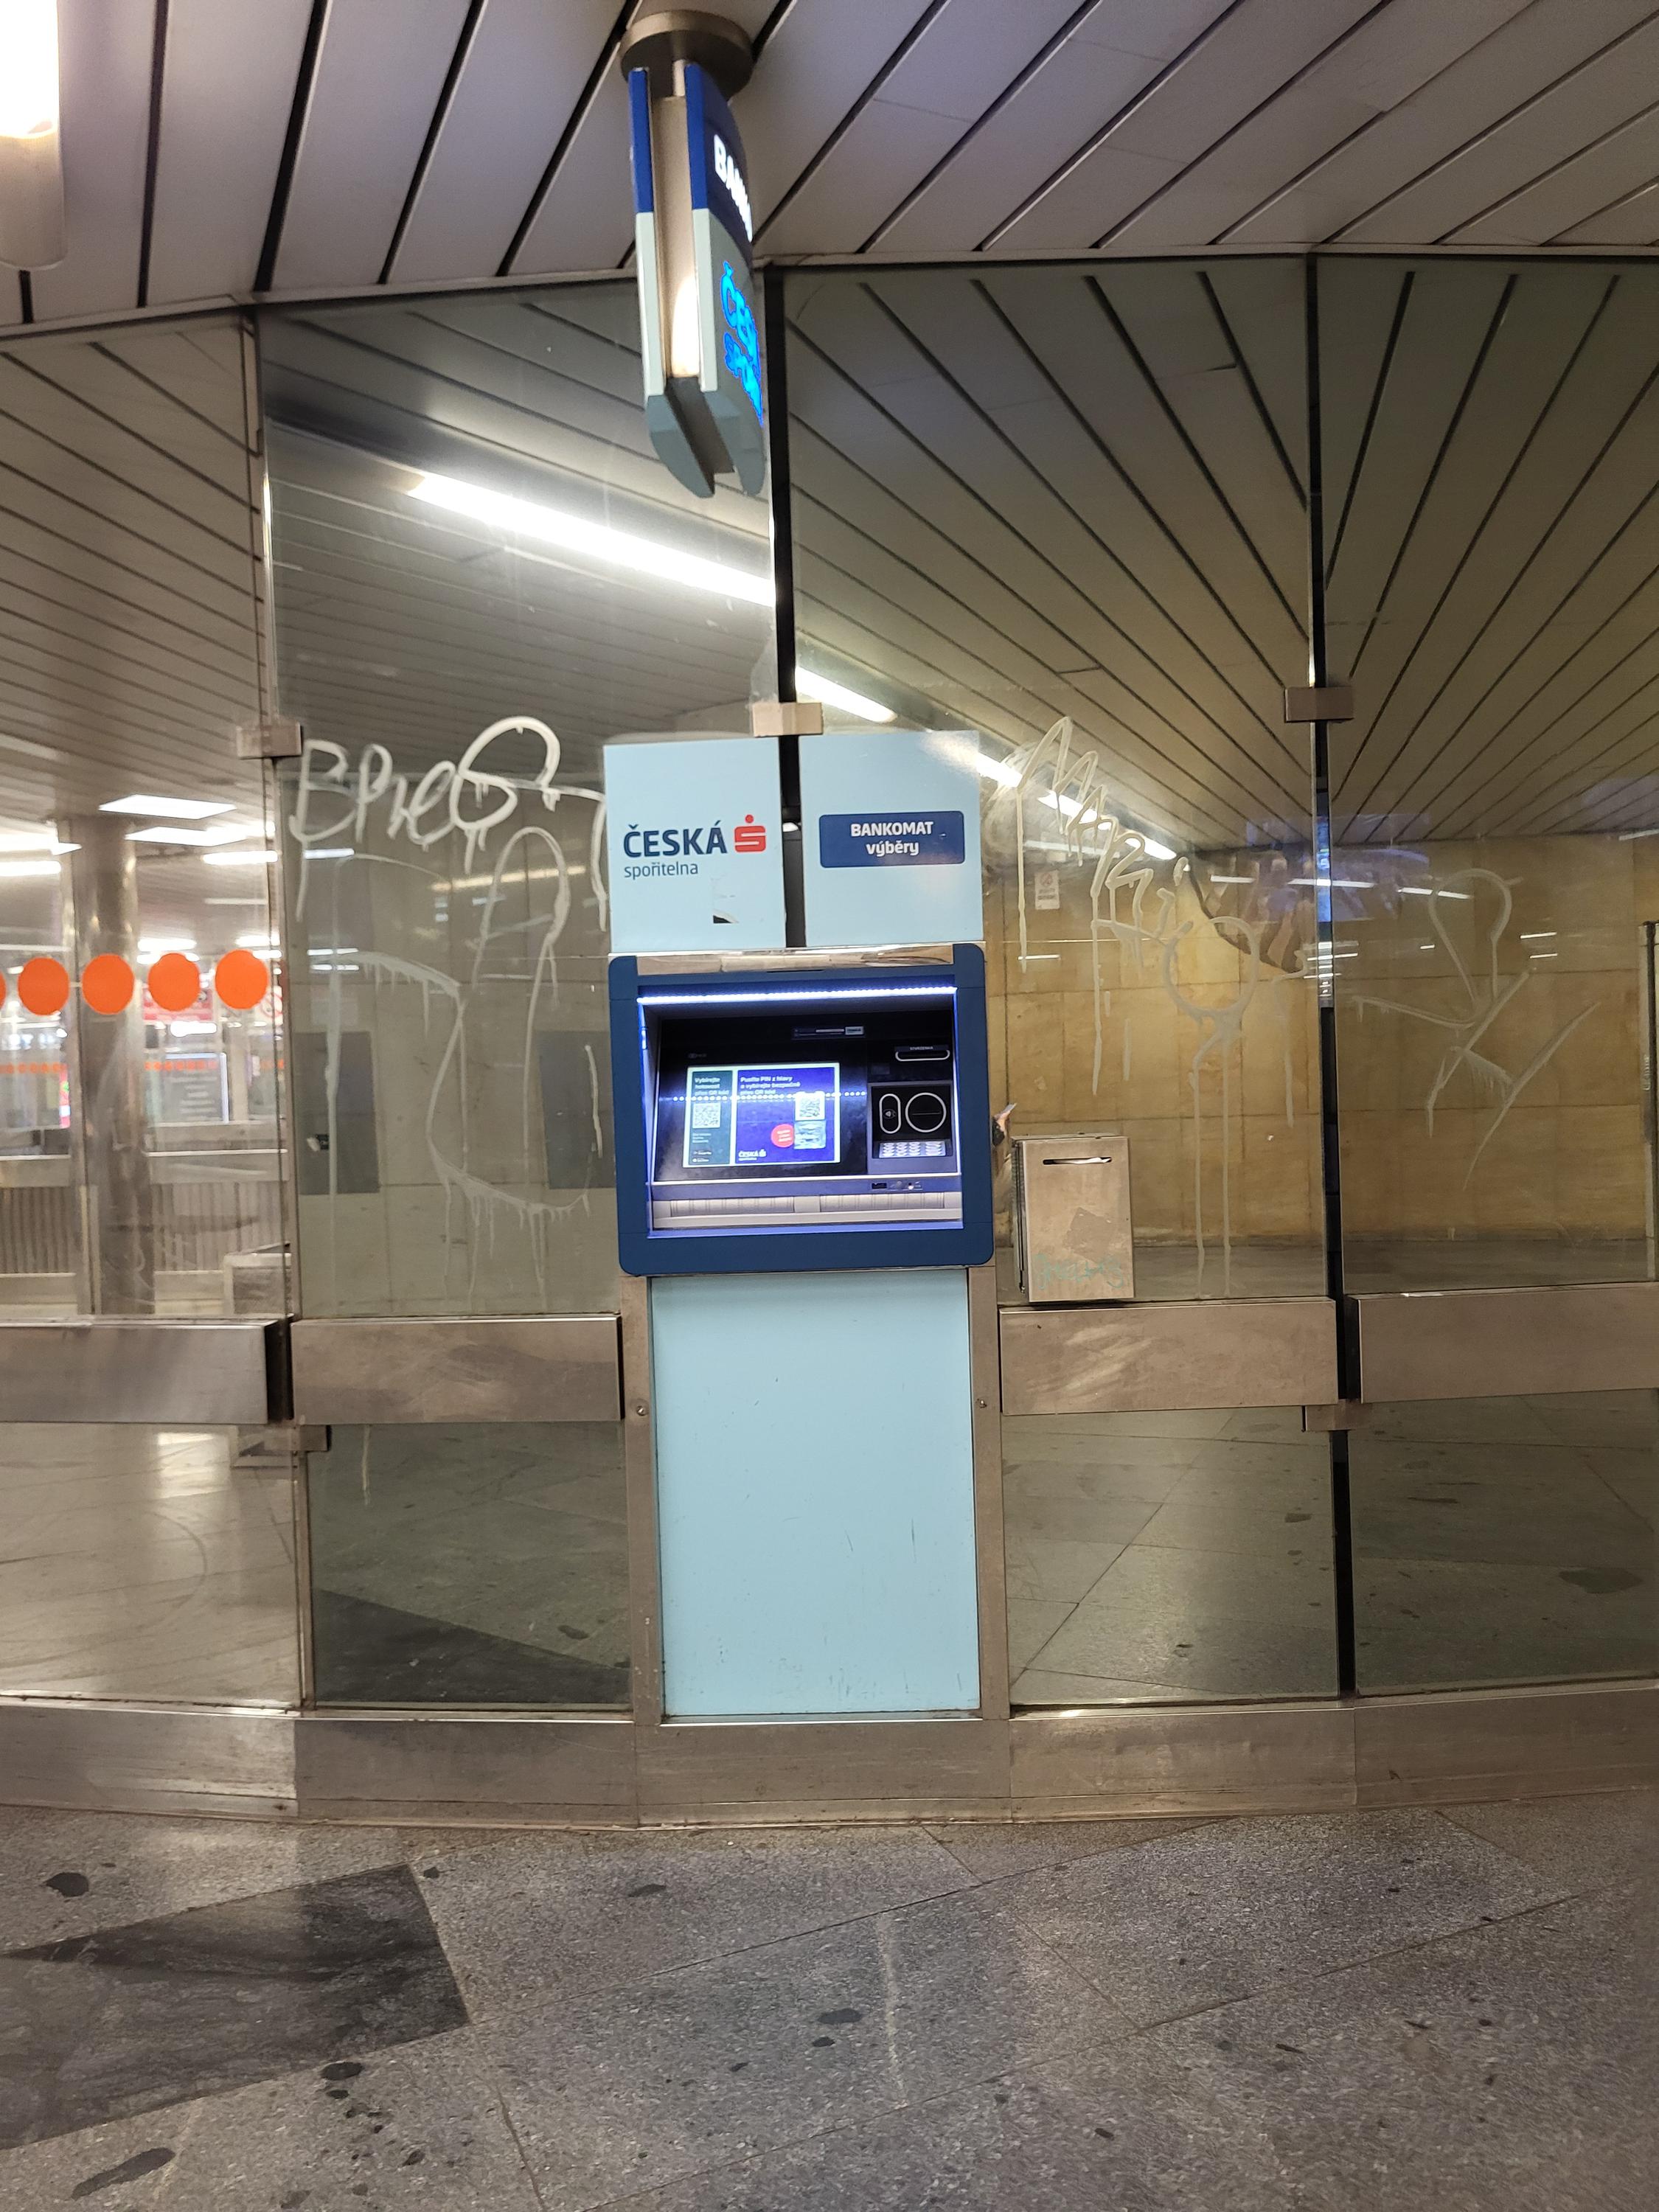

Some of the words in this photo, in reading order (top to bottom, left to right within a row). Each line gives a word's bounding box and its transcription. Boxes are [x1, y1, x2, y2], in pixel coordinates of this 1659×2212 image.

[851, 821, 934, 838] BANKOMAT
[624, 820, 728, 858] ČESKÁ
[866, 840, 919, 857] výběry
[624, 861, 698, 880] spořitelna
